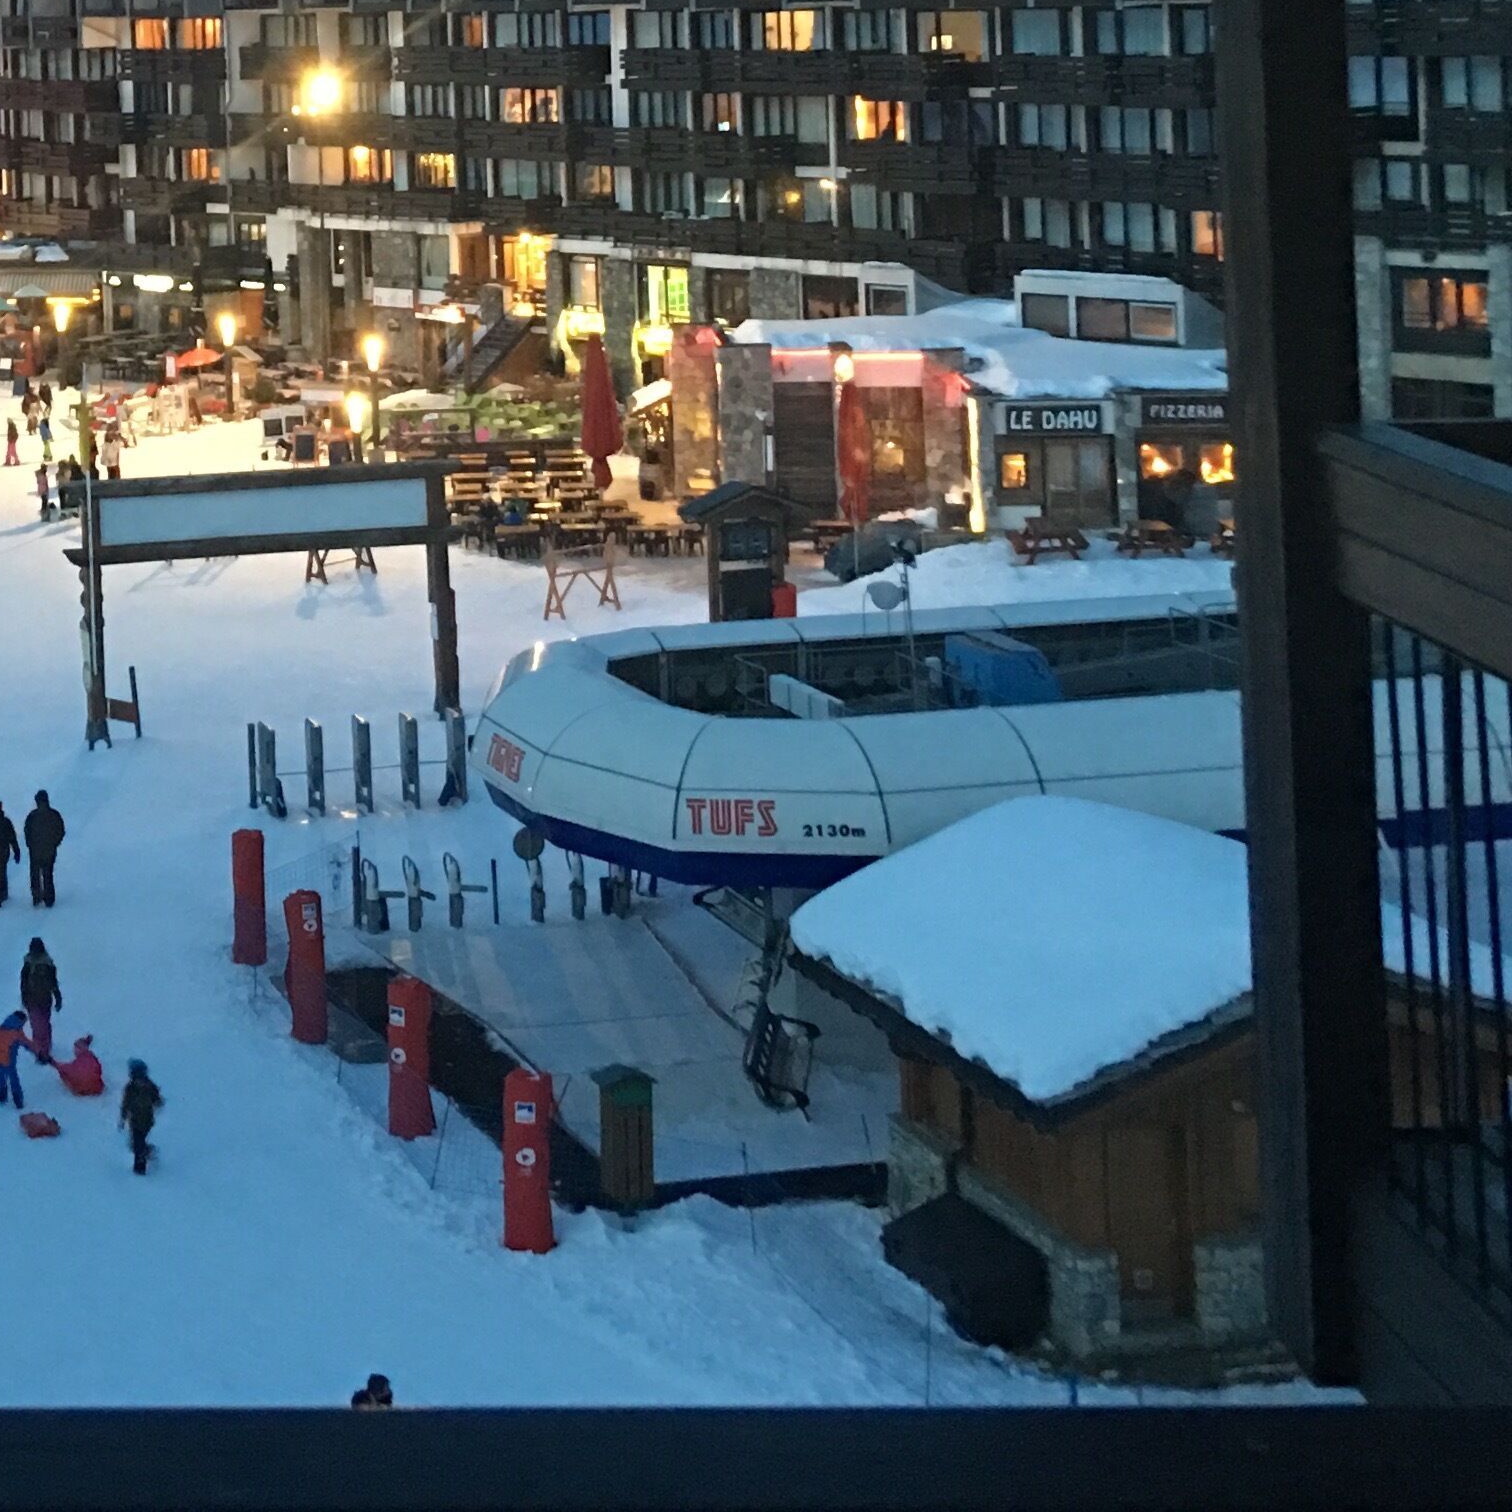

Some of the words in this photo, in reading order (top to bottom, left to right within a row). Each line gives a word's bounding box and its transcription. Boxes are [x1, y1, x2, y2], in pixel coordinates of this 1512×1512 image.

[1009, 410, 1033, 430] LE
[1041, 409, 1098, 430] DAHU
[1149, 403, 1225, 419] PIZZERIA
[685, 798, 778, 837] TUFS
[802, 823, 867, 838] 2130m
